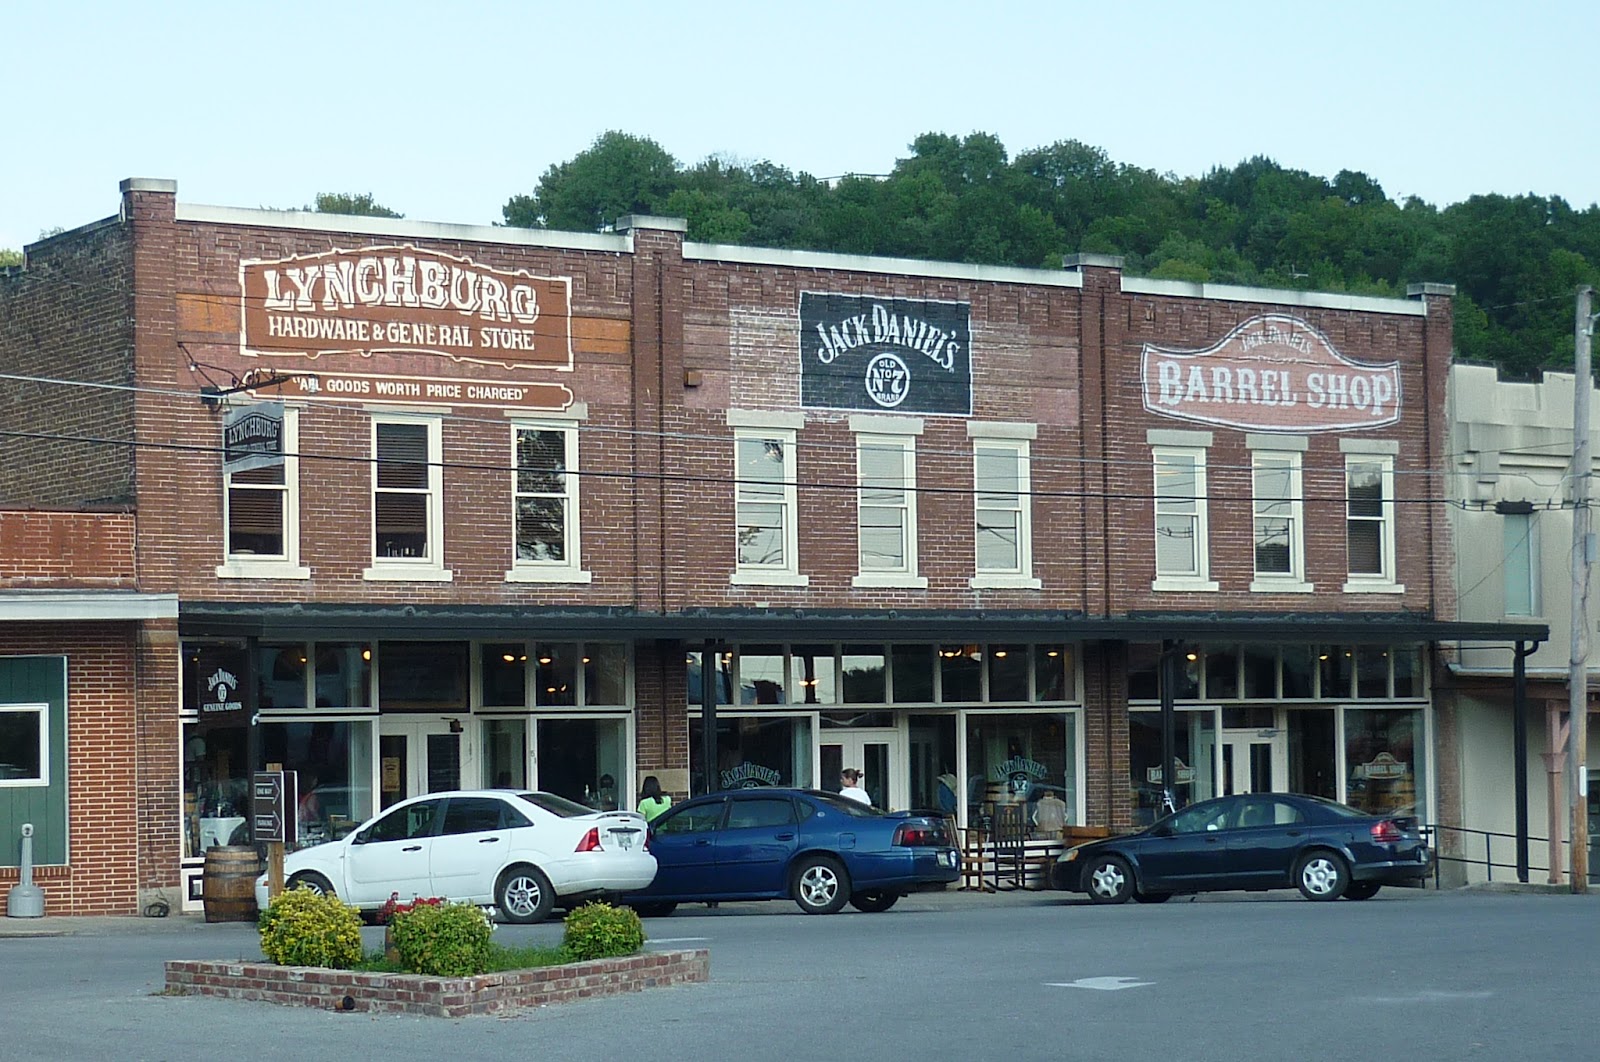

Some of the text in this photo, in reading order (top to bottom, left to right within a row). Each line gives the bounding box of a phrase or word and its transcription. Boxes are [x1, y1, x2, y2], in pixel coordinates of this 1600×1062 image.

[264, 256, 539, 324] LYNCHBURG
[268, 315, 535, 351] HARDWARE & GENERAL STORE
[816, 303, 961, 369] JACK DANIEL'S
[878, 359, 896, 369] OLD
[326, 379, 370, 393] GOODS
[375, 382, 420, 396] WORTH
[426, 384, 462, 398] PRICE
[467, 386, 529, 400] CHARGED"
[1156, 360, 1393, 416] BARREL SHOP
[228, 416, 278, 445] LYNCHBURG
